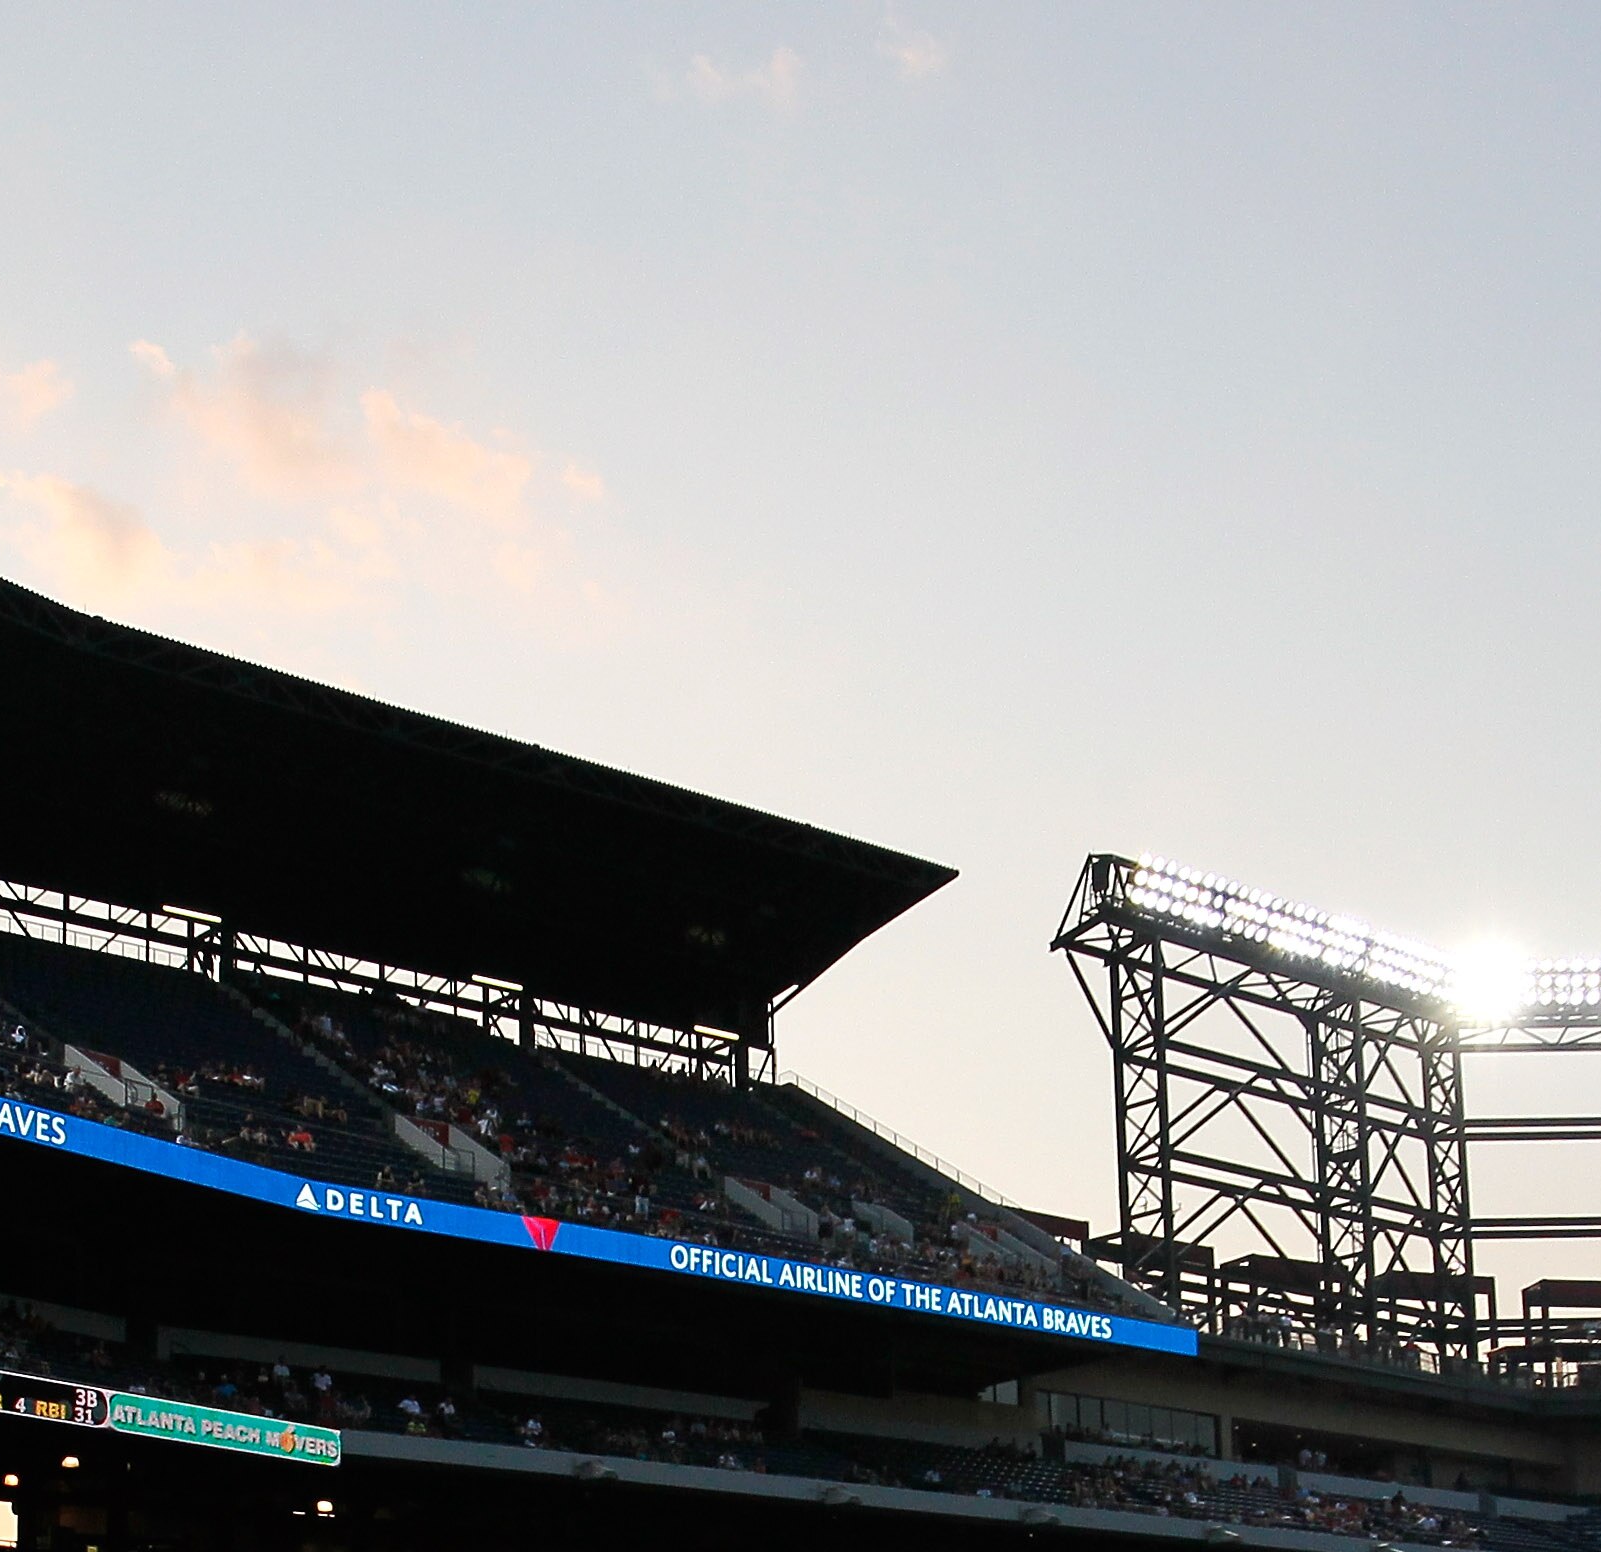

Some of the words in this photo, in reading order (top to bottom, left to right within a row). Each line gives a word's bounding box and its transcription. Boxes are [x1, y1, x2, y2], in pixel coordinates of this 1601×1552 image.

[326, 1188, 423, 1226] DELTA
[670, 1245, 773, 1285] OFFICIAL
[779, 1263, 862, 1299] AIRLINE
[868, 1279, 897, 1303] OF
[901, 1283, 943, 1313] THE
[947, 1292, 1038, 1328] ATLANTA
[1043, 1309, 1113, 1340] BRAVES
[14, 1397, 27, 1413] 4
[35, 1400, 67, 1421] RBI
[74, 1407, 95, 1425] 31
[74, 1388, 98, 1409] 3B
[111, 1404, 196, 1435] ATLANTA
[201, 1418, 261, 1445] PEACH
